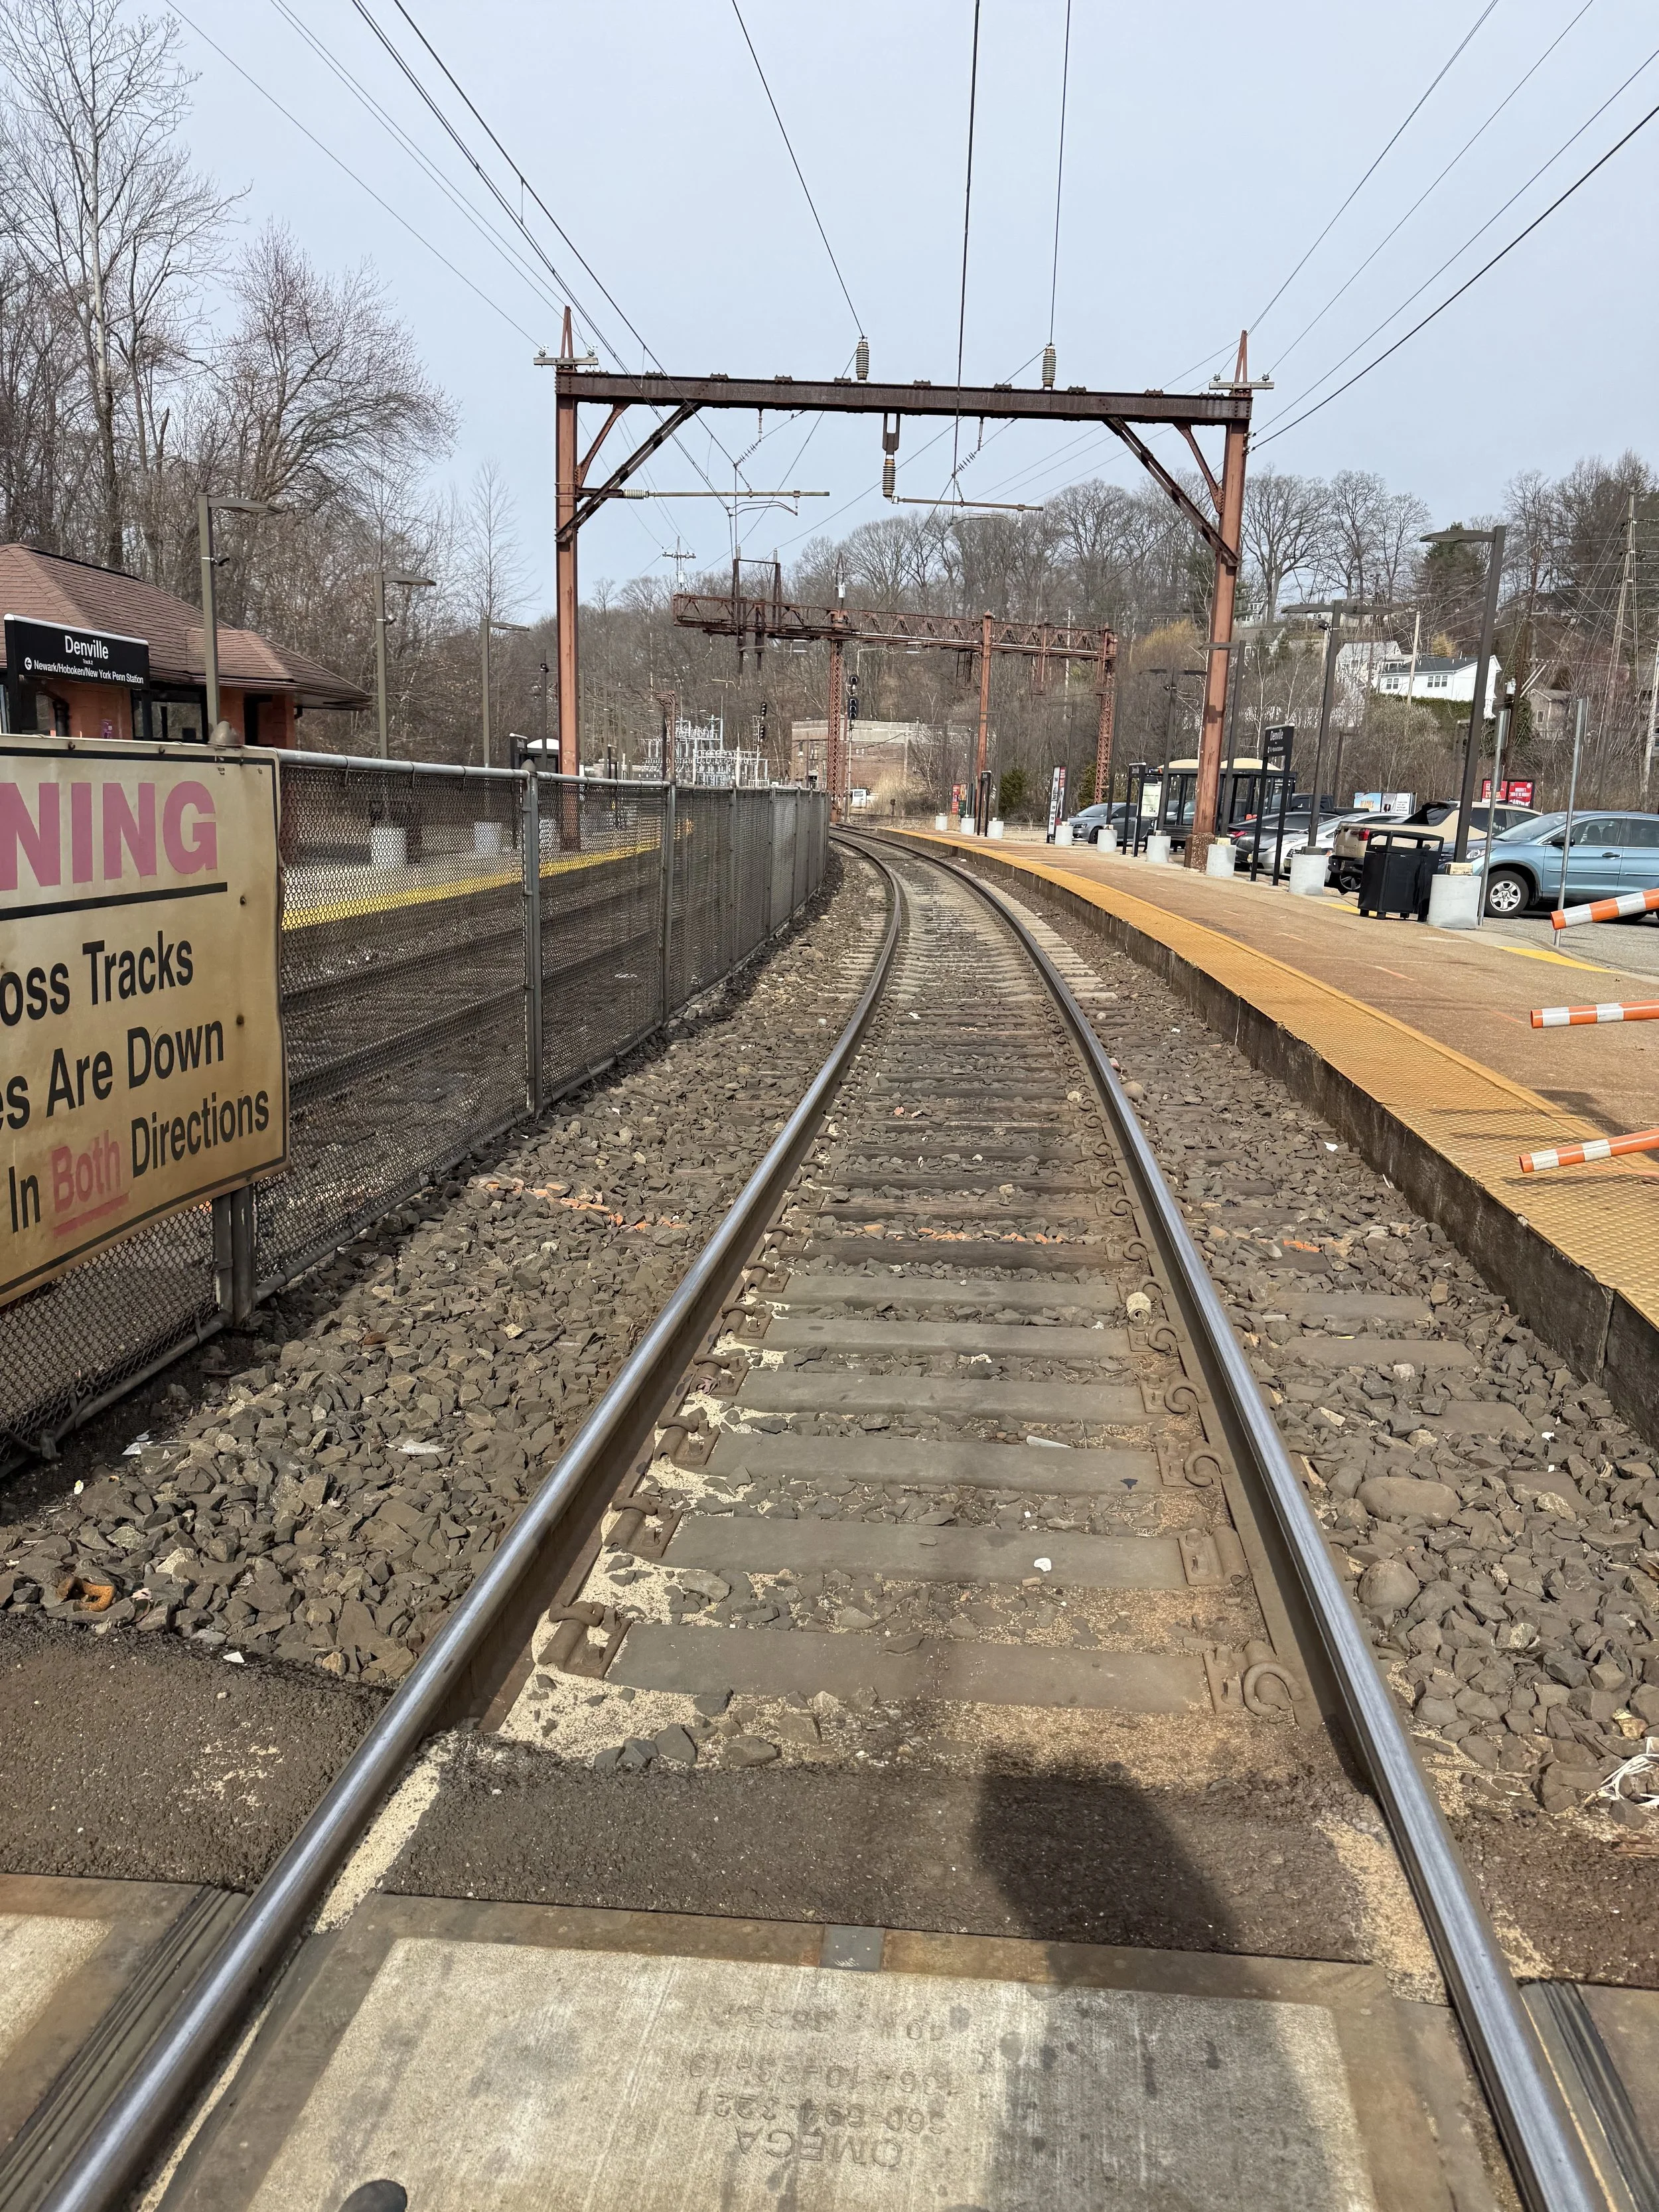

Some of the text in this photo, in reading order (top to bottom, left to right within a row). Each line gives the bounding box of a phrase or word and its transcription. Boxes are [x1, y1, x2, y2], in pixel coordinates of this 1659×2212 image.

[34, 659, 144, 684] Newark/Hoboken/New York Penn Station
[64, 634, 109, 660] Denville
[0, 780, 218, 891] NING
[0, 930, 194, 1027] oss Tracks
[46, 1047, 113, 1118] Are
[127, 1020, 224, 1090] Down
[8, 1090, 269, 1234] In Both Directions
[694, 2090, 947, 2135] 360-694-3221
[734, 2126, 903, 2168] OMEGA
